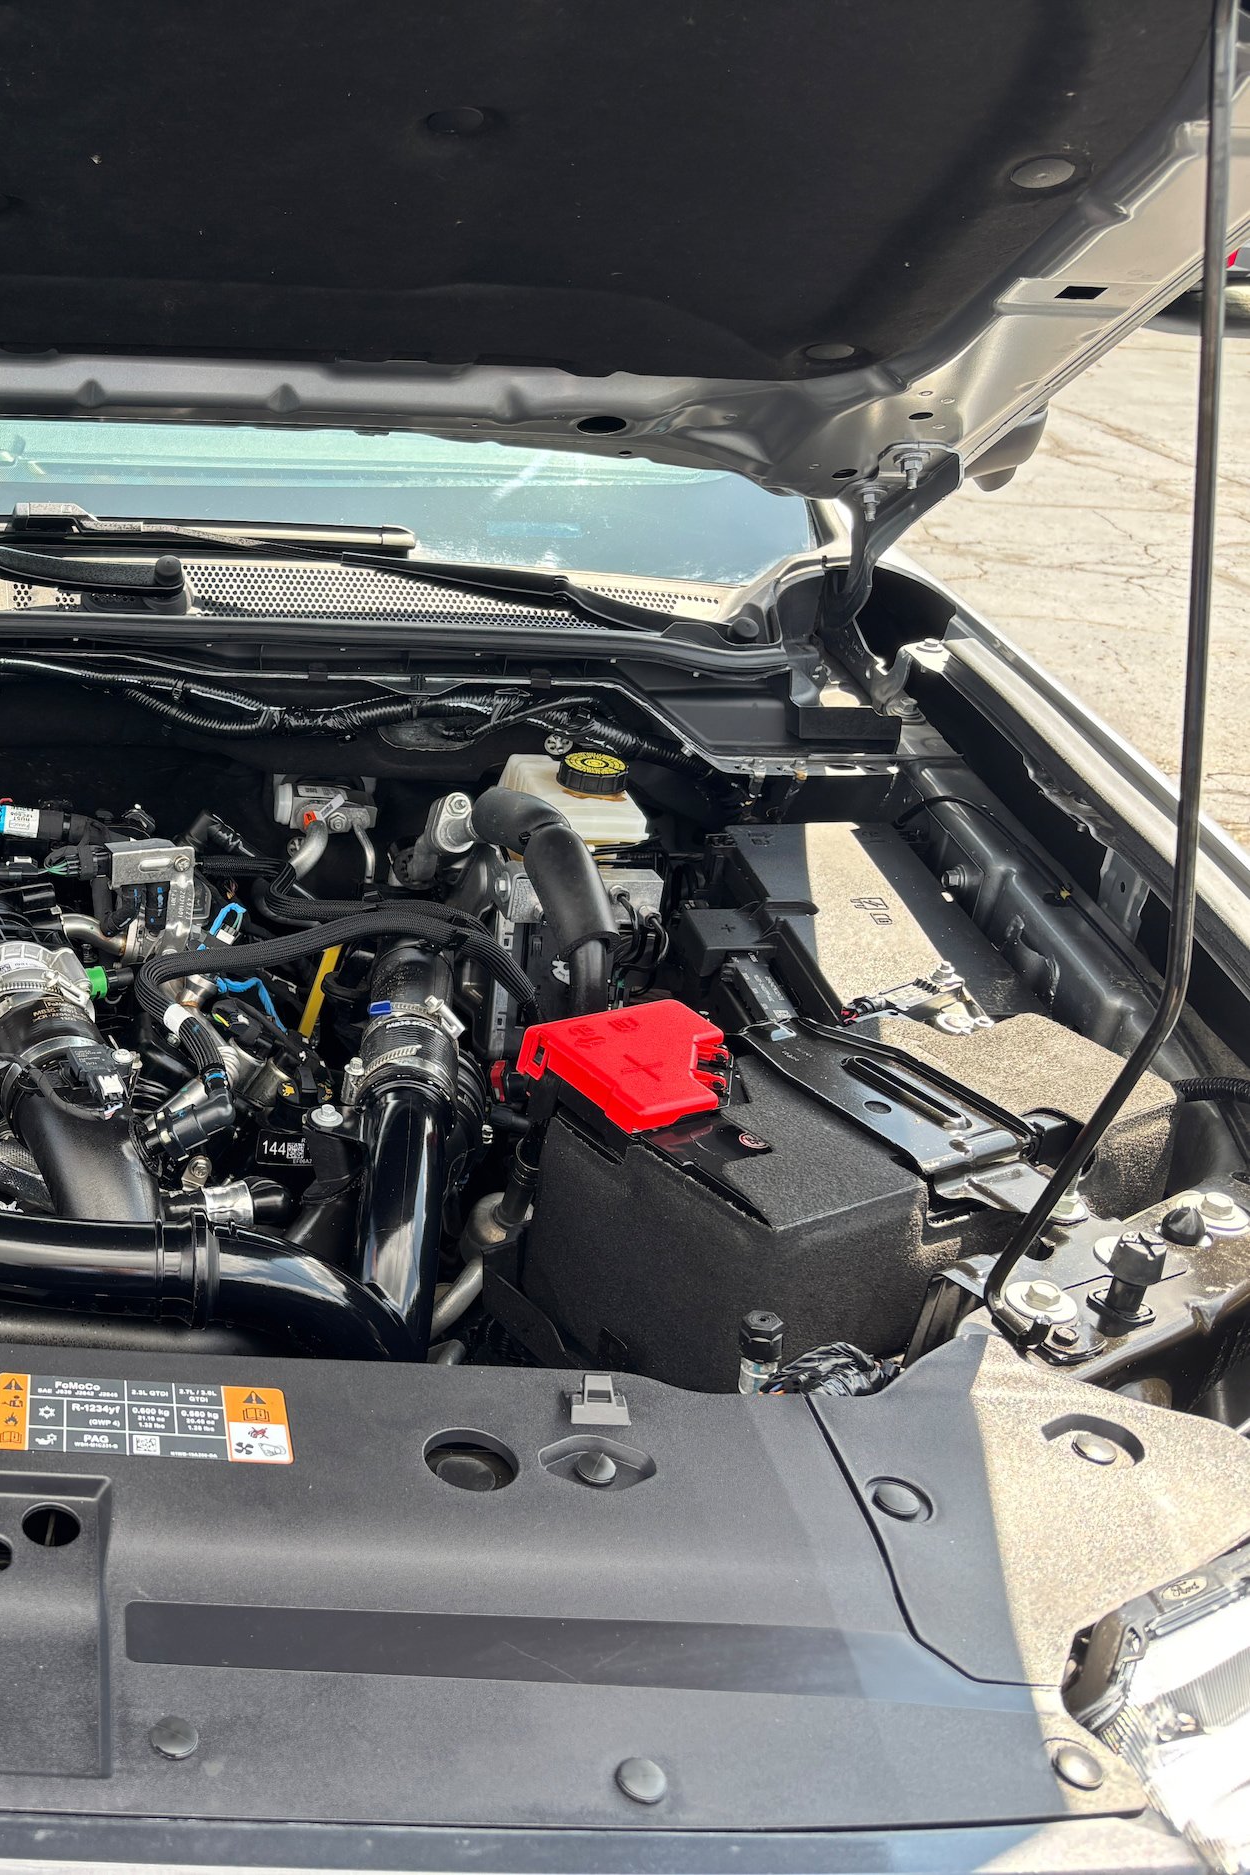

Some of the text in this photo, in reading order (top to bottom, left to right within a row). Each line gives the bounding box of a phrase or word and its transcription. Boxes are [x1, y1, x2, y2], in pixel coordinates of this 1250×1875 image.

[262, 1140, 286, 1156] 144
[54, 1381, 101, 1391] FoMoCo
[71, 1403, 121, 1415] R-1234yf
[158, 1408, 170, 1417] kg
[206, 1411, 219, 1420] kg
[88, 1418, 121, 1427] (GWP 4)
[83, 1434, 109, 1443] PAG
